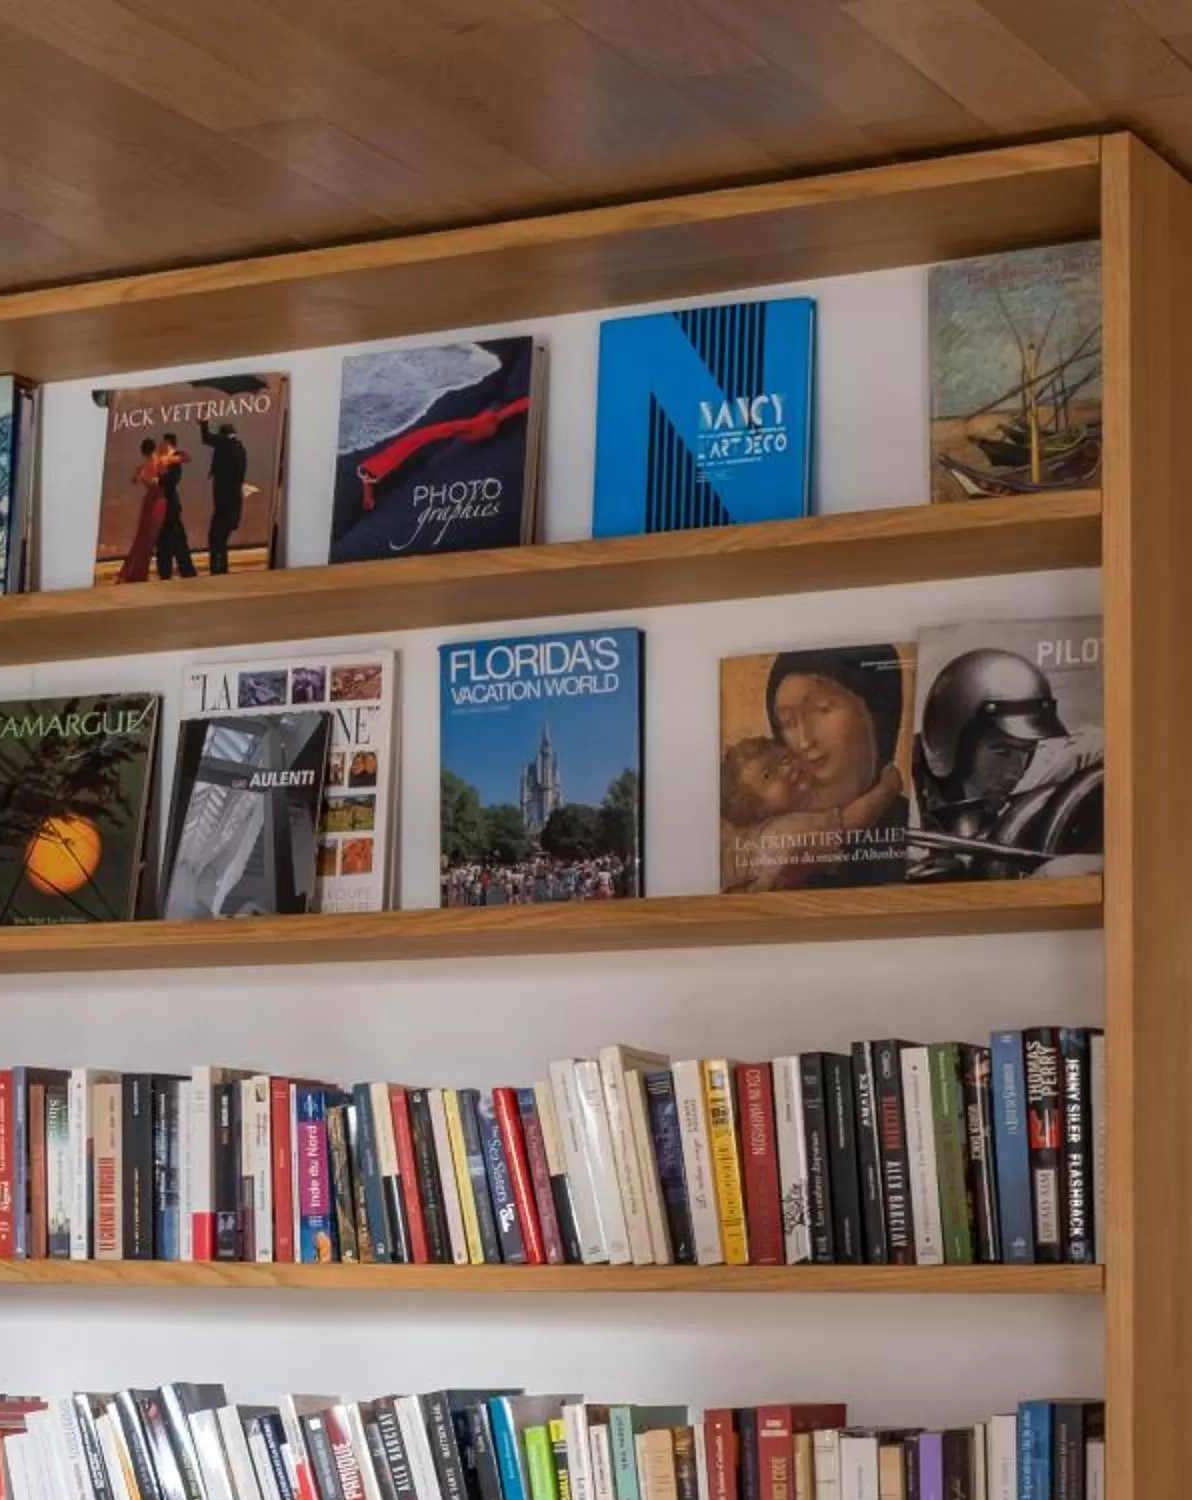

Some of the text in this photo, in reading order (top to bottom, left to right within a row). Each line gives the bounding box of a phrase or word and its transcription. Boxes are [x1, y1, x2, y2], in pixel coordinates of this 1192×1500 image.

[113, 394, 272, 432] JACK VETTRIANO
[412, 477, 502, 507] PHOTO
[450, 636, 620, 683] FLORIDA'S
[1037, 637, 1099, 665] PILO
[451, 672, 620, 705] VACATION WORLD
[249, 769, 316, 790] AULENTI
[846, 826, 905, 845] ITALIE
[1026, 1040, 1043, 1104] THOMAS
[1040, 1044, 1058, 1097] PERRY
[750, 1103, 768, 1156] HARRISON
[1065, 1058, 1084, 1237] JENNY SILER FLASHBACK
[307, 1124, 322, 1207] Inde du Nord
[885, 1160, 904, 1189] ALEX
[888, 1195, 908, 1248] BARCLAY
[332, 1439, 363, 1500] PANIQUE
[379, 1412, 412, 1492] ALEX BARCLAY
